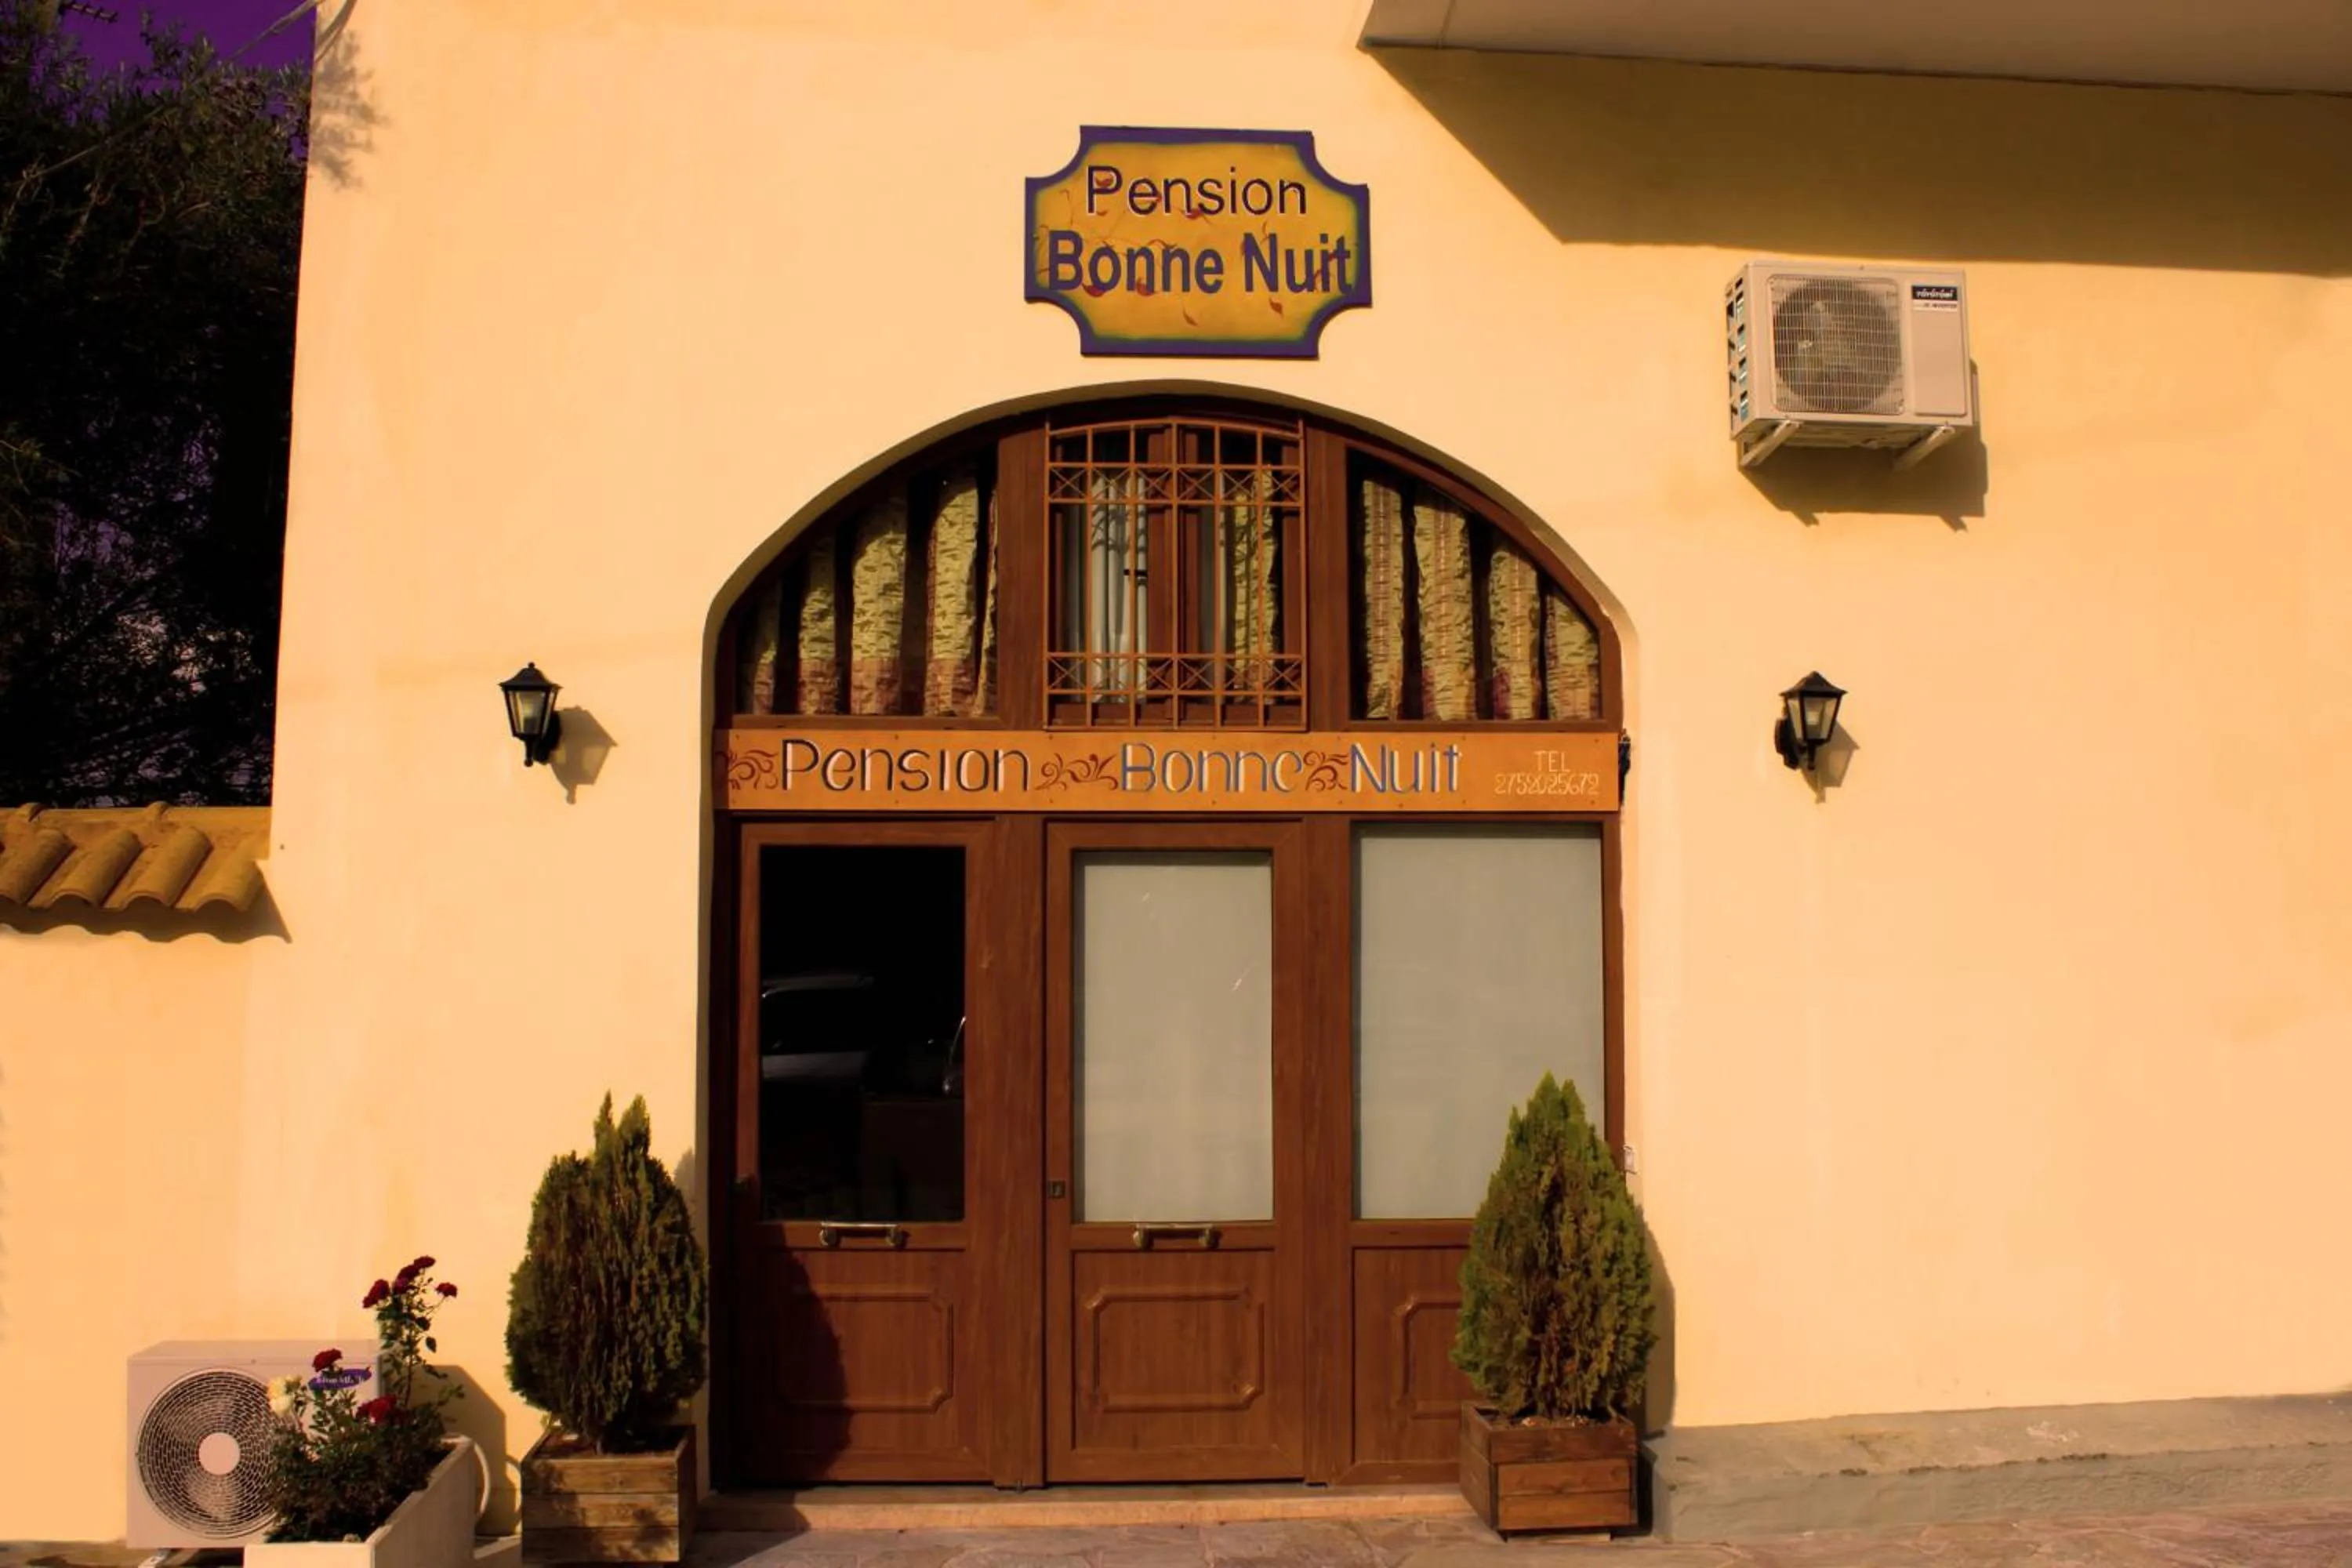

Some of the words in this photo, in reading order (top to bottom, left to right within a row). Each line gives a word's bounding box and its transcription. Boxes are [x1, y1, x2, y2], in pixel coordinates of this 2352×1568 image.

[1087, 165, 1307, 215] Pension
[1049, 230, 1224, 293] Bonne
[1243, 232, 1353, 292] Nuit
[782, 739, 1029, 792] Pension
[1350, 742, 1462, 793] Nuit
[1534, 750, 1570, 772] TEL
